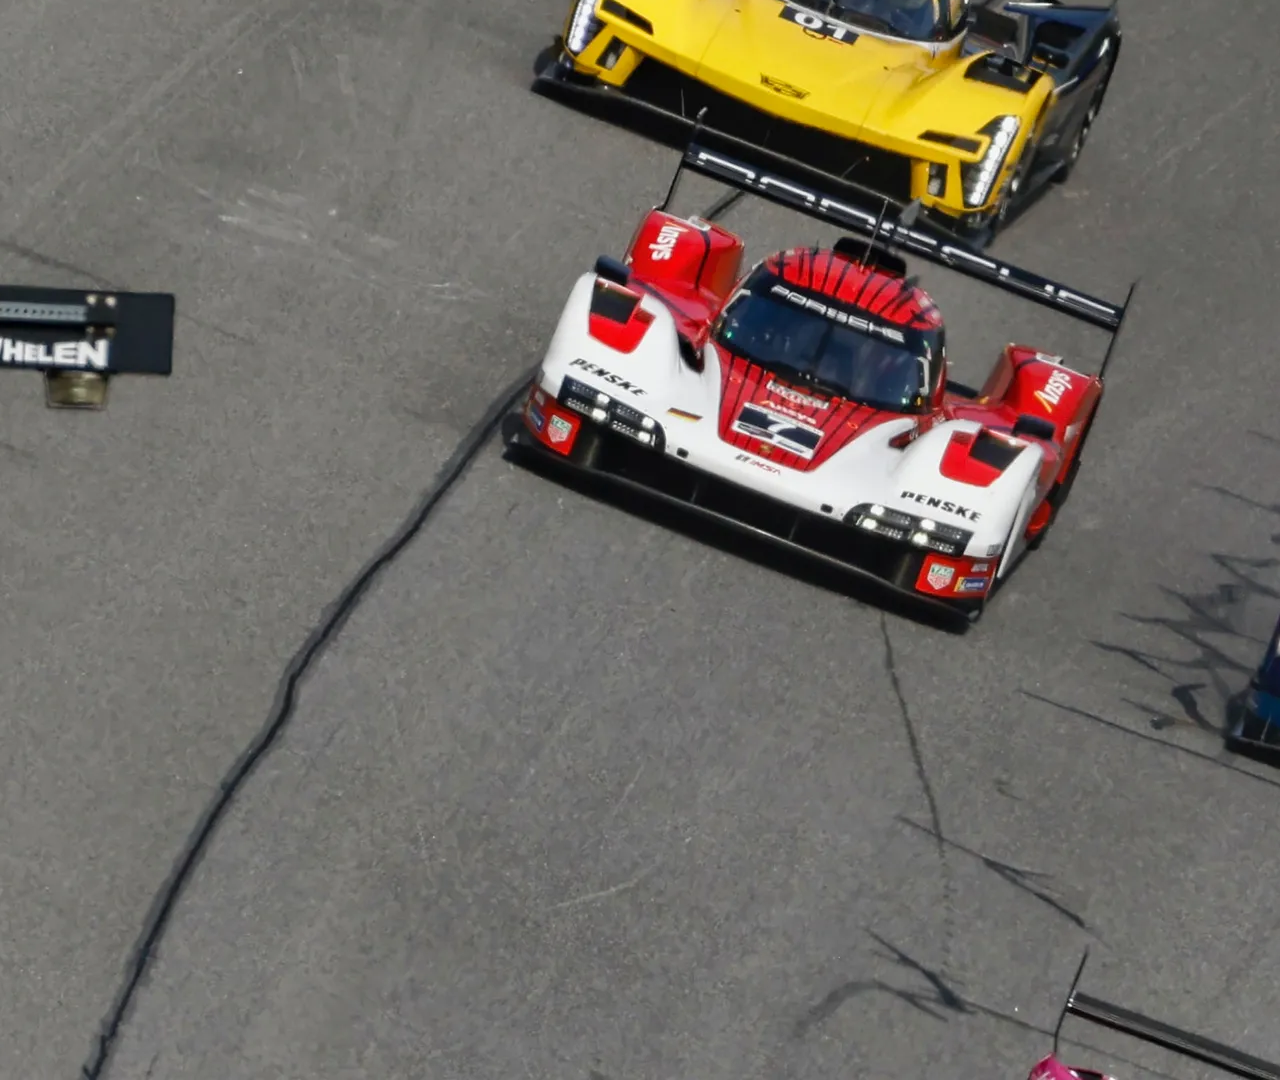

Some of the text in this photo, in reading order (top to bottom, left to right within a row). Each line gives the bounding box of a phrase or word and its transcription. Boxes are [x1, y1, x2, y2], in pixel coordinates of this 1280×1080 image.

[794, 12, 847, 40] 01
[648, 221, 690, 261] Ansys
[771, 284, 905, 344] PORSCHE
[569, 358, 648, 396] PENSKE
[1034, 369, 1072, 413] Ansys
[900, 491, 982, 523] PENSKE
